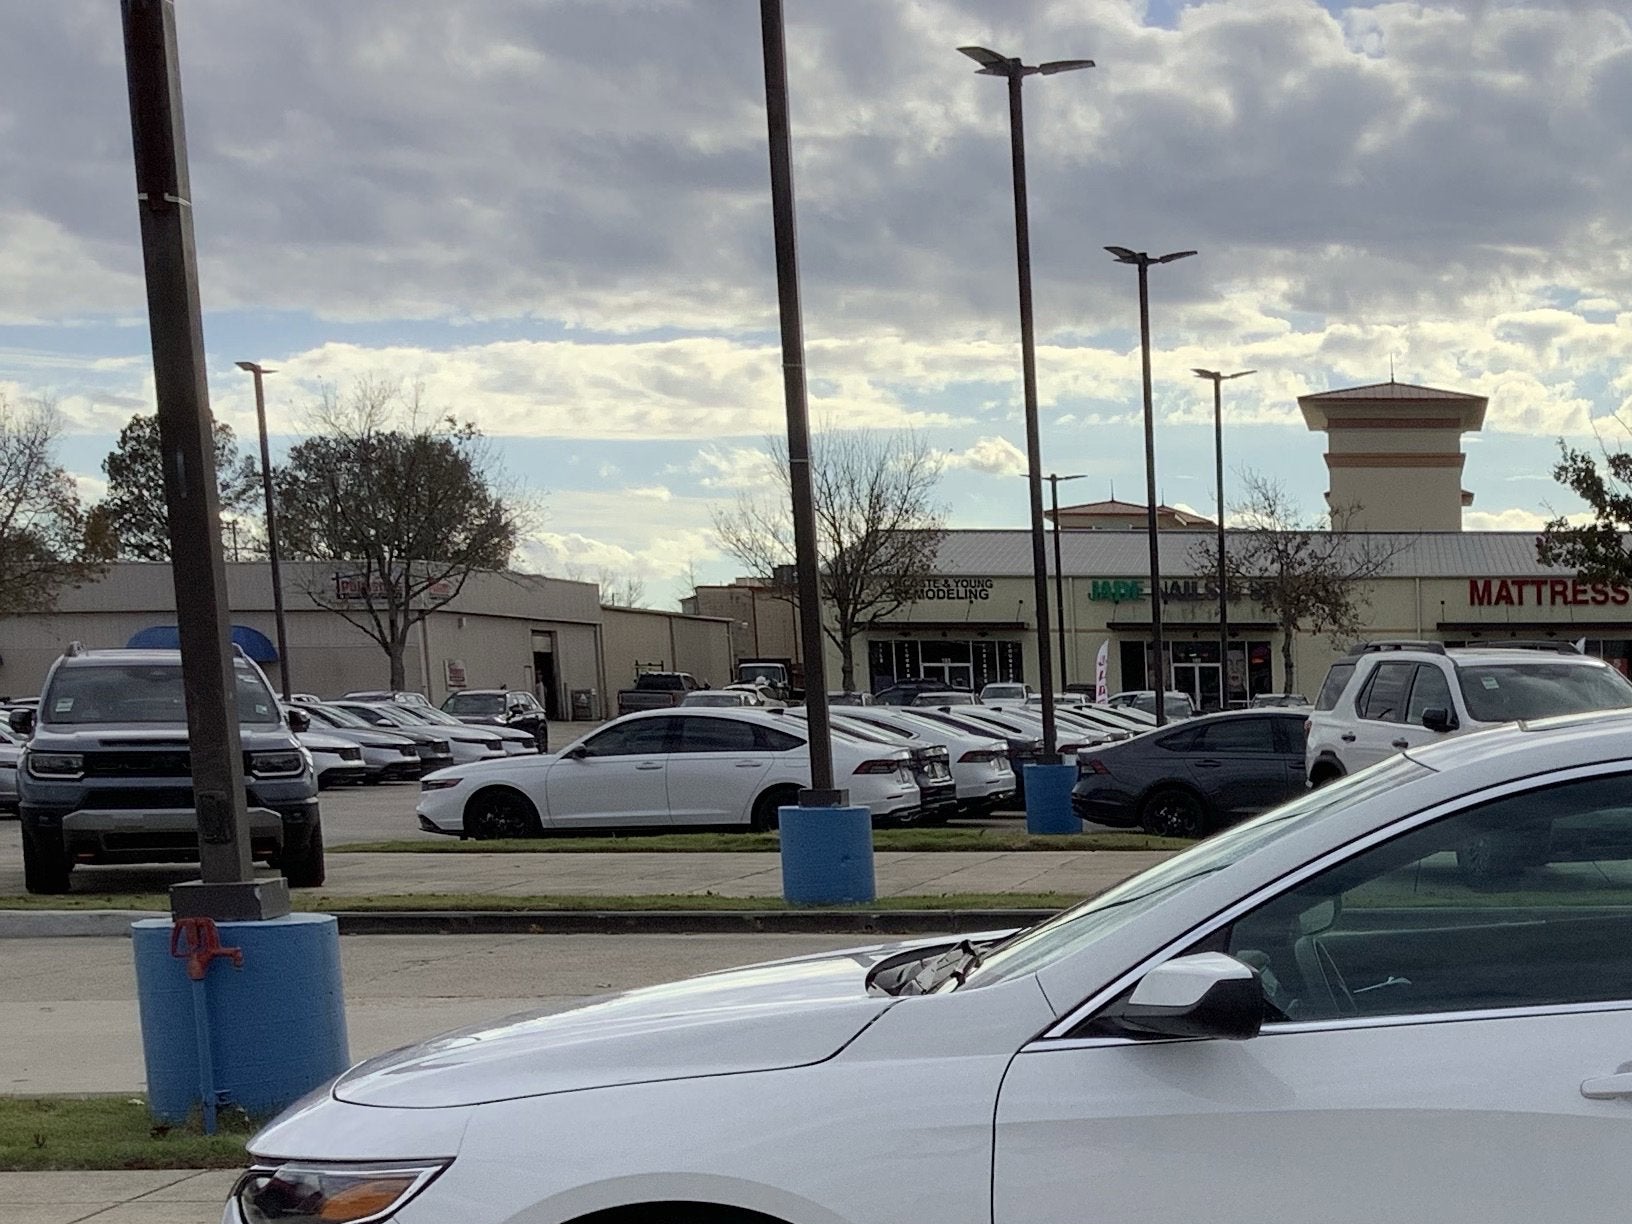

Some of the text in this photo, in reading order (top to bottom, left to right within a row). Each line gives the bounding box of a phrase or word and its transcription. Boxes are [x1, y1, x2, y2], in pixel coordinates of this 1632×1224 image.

[953, 579, 993, 588] YOUNG
[1092, 580, 1143, 600] JADE
[1469, 578, 1630, 606] MATTRESS
